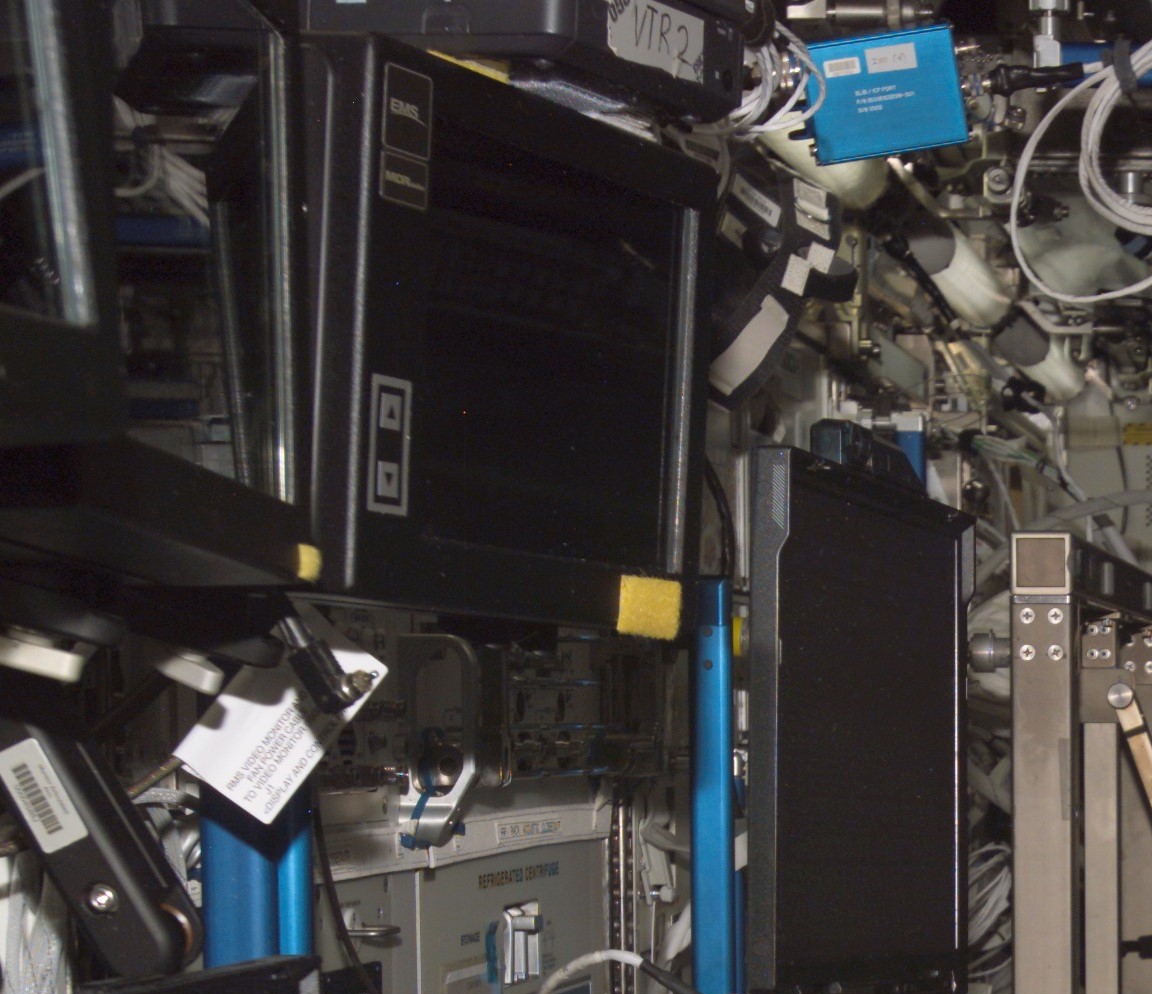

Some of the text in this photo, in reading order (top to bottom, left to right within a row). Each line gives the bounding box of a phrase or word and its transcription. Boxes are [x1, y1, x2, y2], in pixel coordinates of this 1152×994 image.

[633, 3, 671, 55] VTR
[677, 24, 695, 67] 2
[389, 96, 419, 120] EMS
[241, 744, 266, 772] VIDEO
[261, 707, 296, 747] MONITOR
[244, 725, 308, 804] TO VIDEO MONITOR
[247, 764, 264, 783] FAN
[260, 733, 288, 766] POWER
[291, 757, 309, 777] AND
[478, 861, 560, 890] REFRIGERATED CENTRIFUGE
